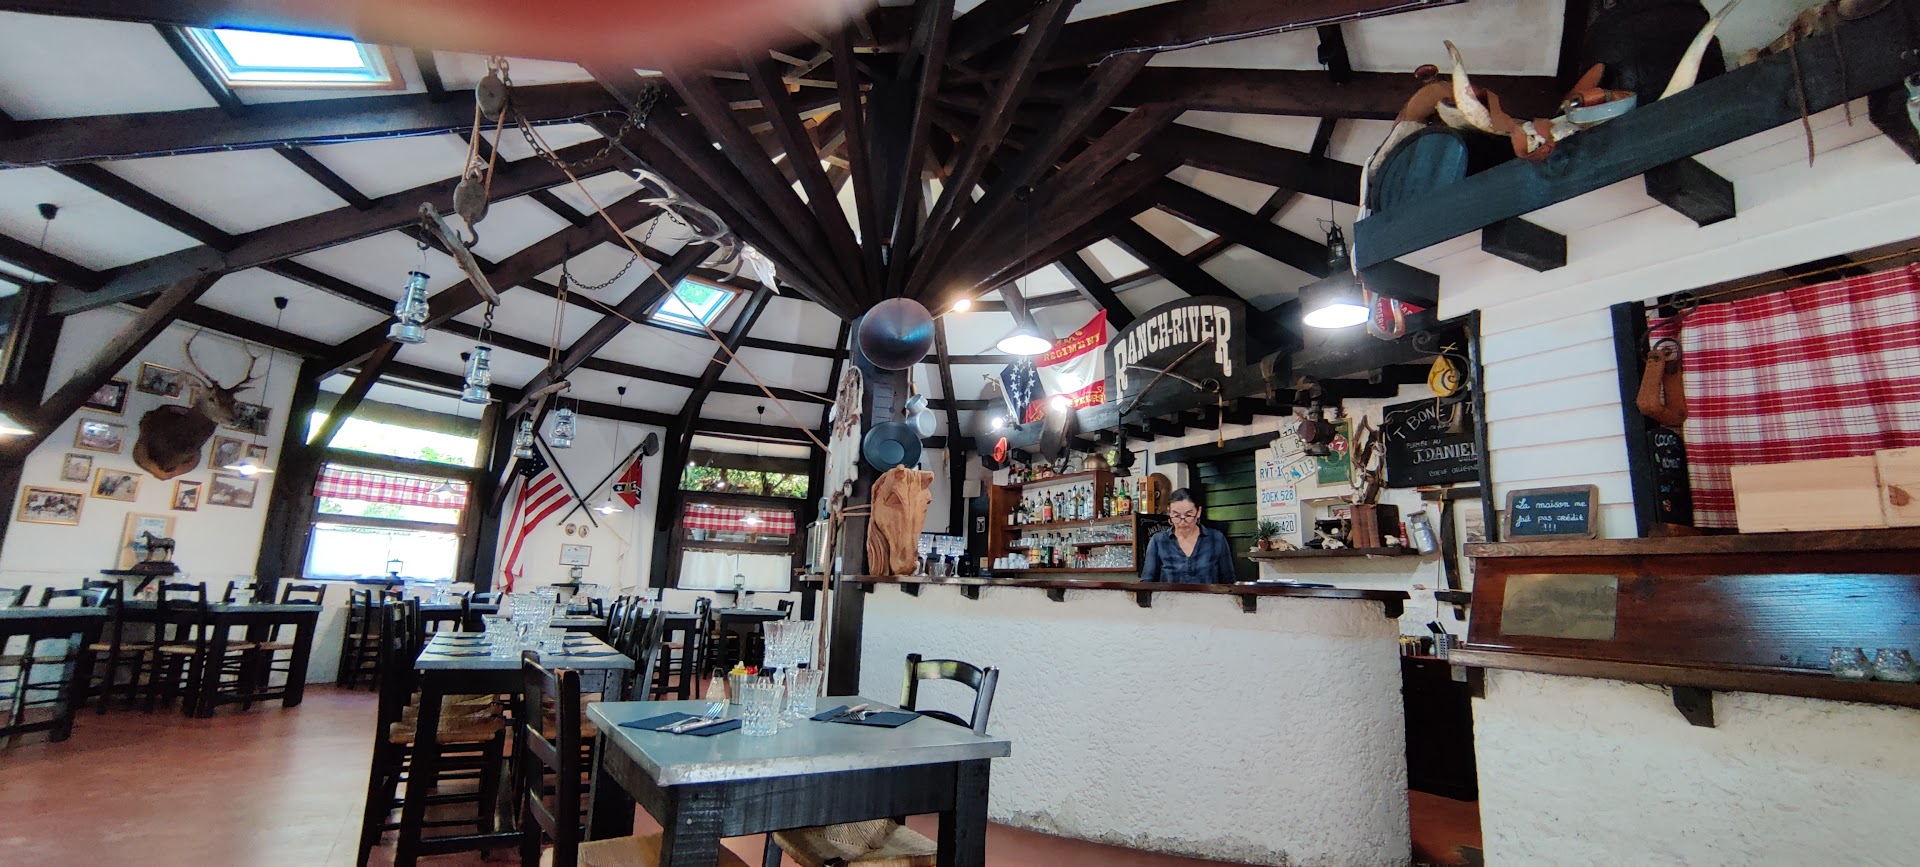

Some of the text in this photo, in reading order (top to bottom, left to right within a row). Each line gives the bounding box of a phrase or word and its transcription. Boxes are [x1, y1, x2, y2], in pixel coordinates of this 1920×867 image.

[1114, 305, 1232, 405] RANCH-RIVER
[1281, 489, 1294, 501] 528
[1535, 500, 1571, 509] maison
[1537, 515, 1553, 524] pas
